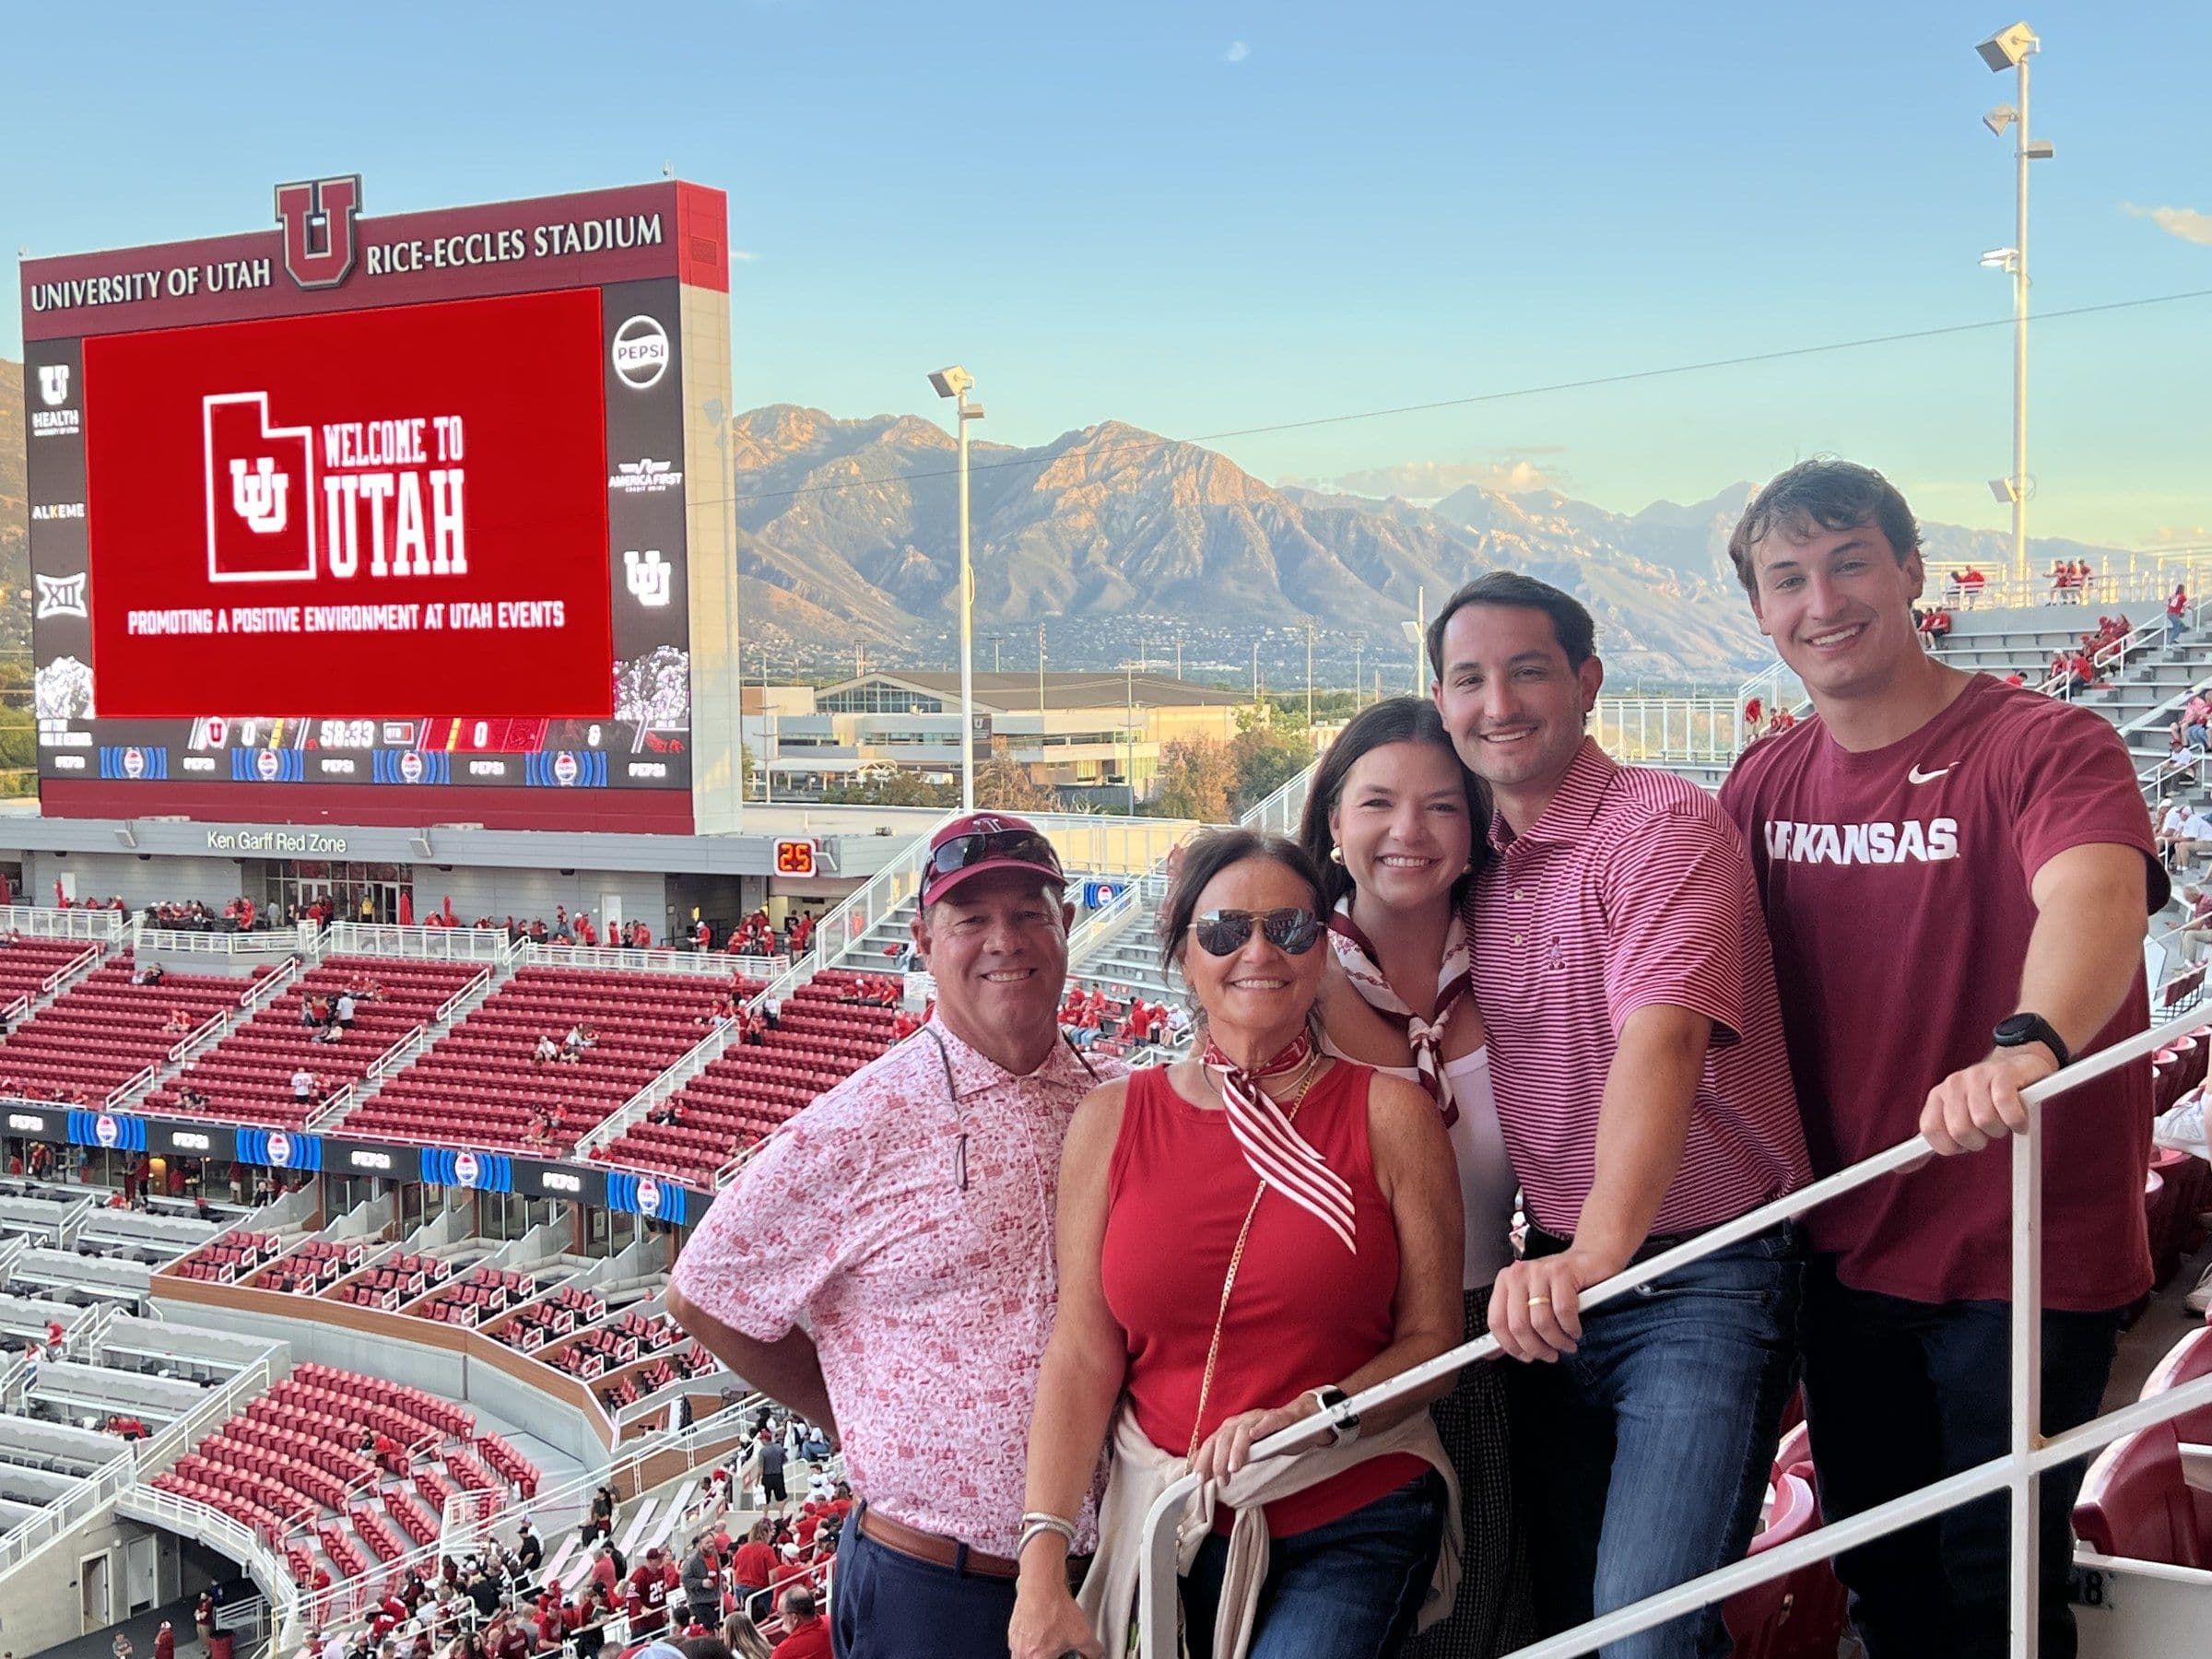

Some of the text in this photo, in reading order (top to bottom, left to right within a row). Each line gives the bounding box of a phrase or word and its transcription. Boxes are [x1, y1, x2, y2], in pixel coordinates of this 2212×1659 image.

[275, 173, 362, 291] U
[367, 213, 663, 275] RICE-ECCLES STADIUM
[31, 258, 271, 312] UNIVERSITY OF UTAH
[618, 344, 665, 360] PEPSI
[32, 409, 79, 428] HEALTH
[323, 415, 464, 468] WELCOME TO
[609, 472, 683, 488] AMERICA FIRST
[32, 503, 85, 519] ALKEME
[324, 468, 468, 578] UTAH
[128, 600, 566, 635] PROMOTING A POSITIVE ENVIRONMENT AT UTAH EVENTS
[241, 721, 256, 746] 0
[474, 721, 488, 747] 0
[207, 831, 347, 853] Ken Garff Red Zone
[779, 842, 811, 872] 25
